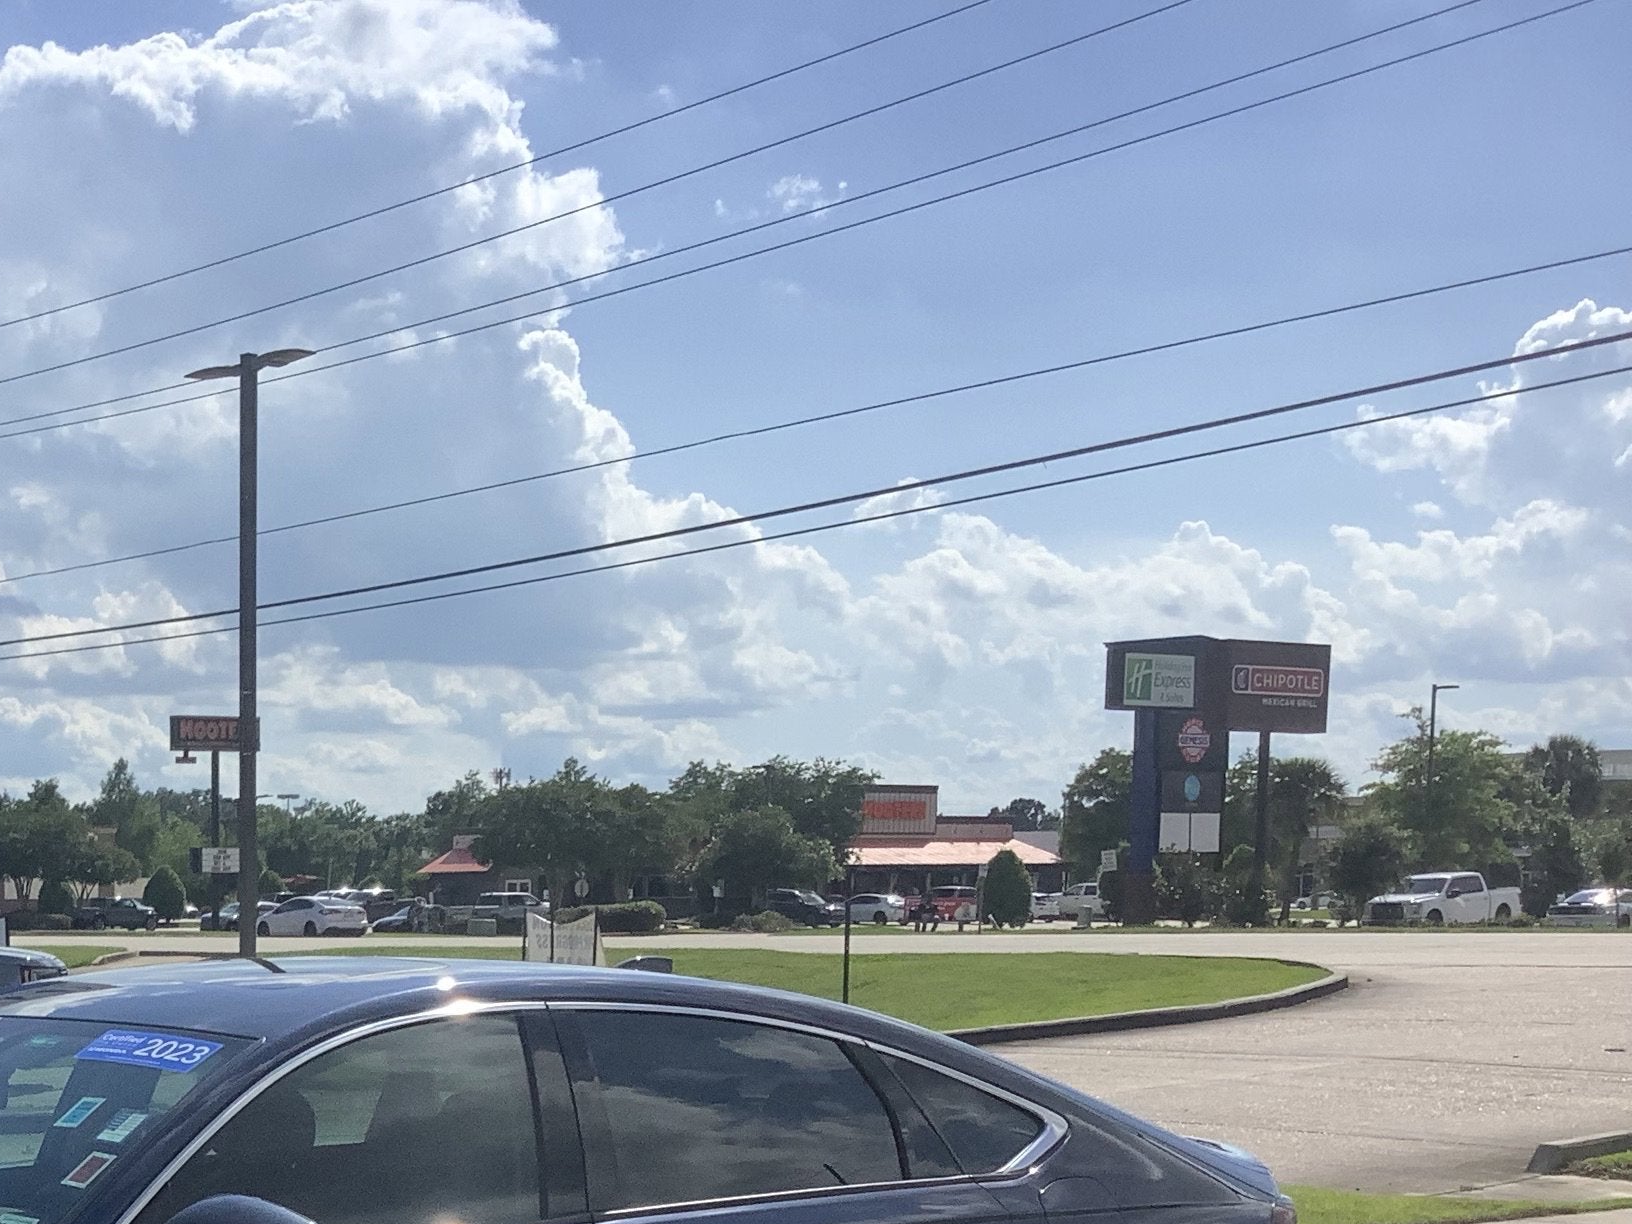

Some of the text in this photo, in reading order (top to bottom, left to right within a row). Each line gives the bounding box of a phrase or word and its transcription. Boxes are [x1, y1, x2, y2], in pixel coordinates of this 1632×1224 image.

[1153, 671, 1192, 691] Express
[1253, 673, 1320, 690] CHIPOTLE
[1262, 698, 1318, 708] MEXICAN GRILL
[102, 1033, 148, 1046] Certified
[132, 1038, 211, 1065] 2023
